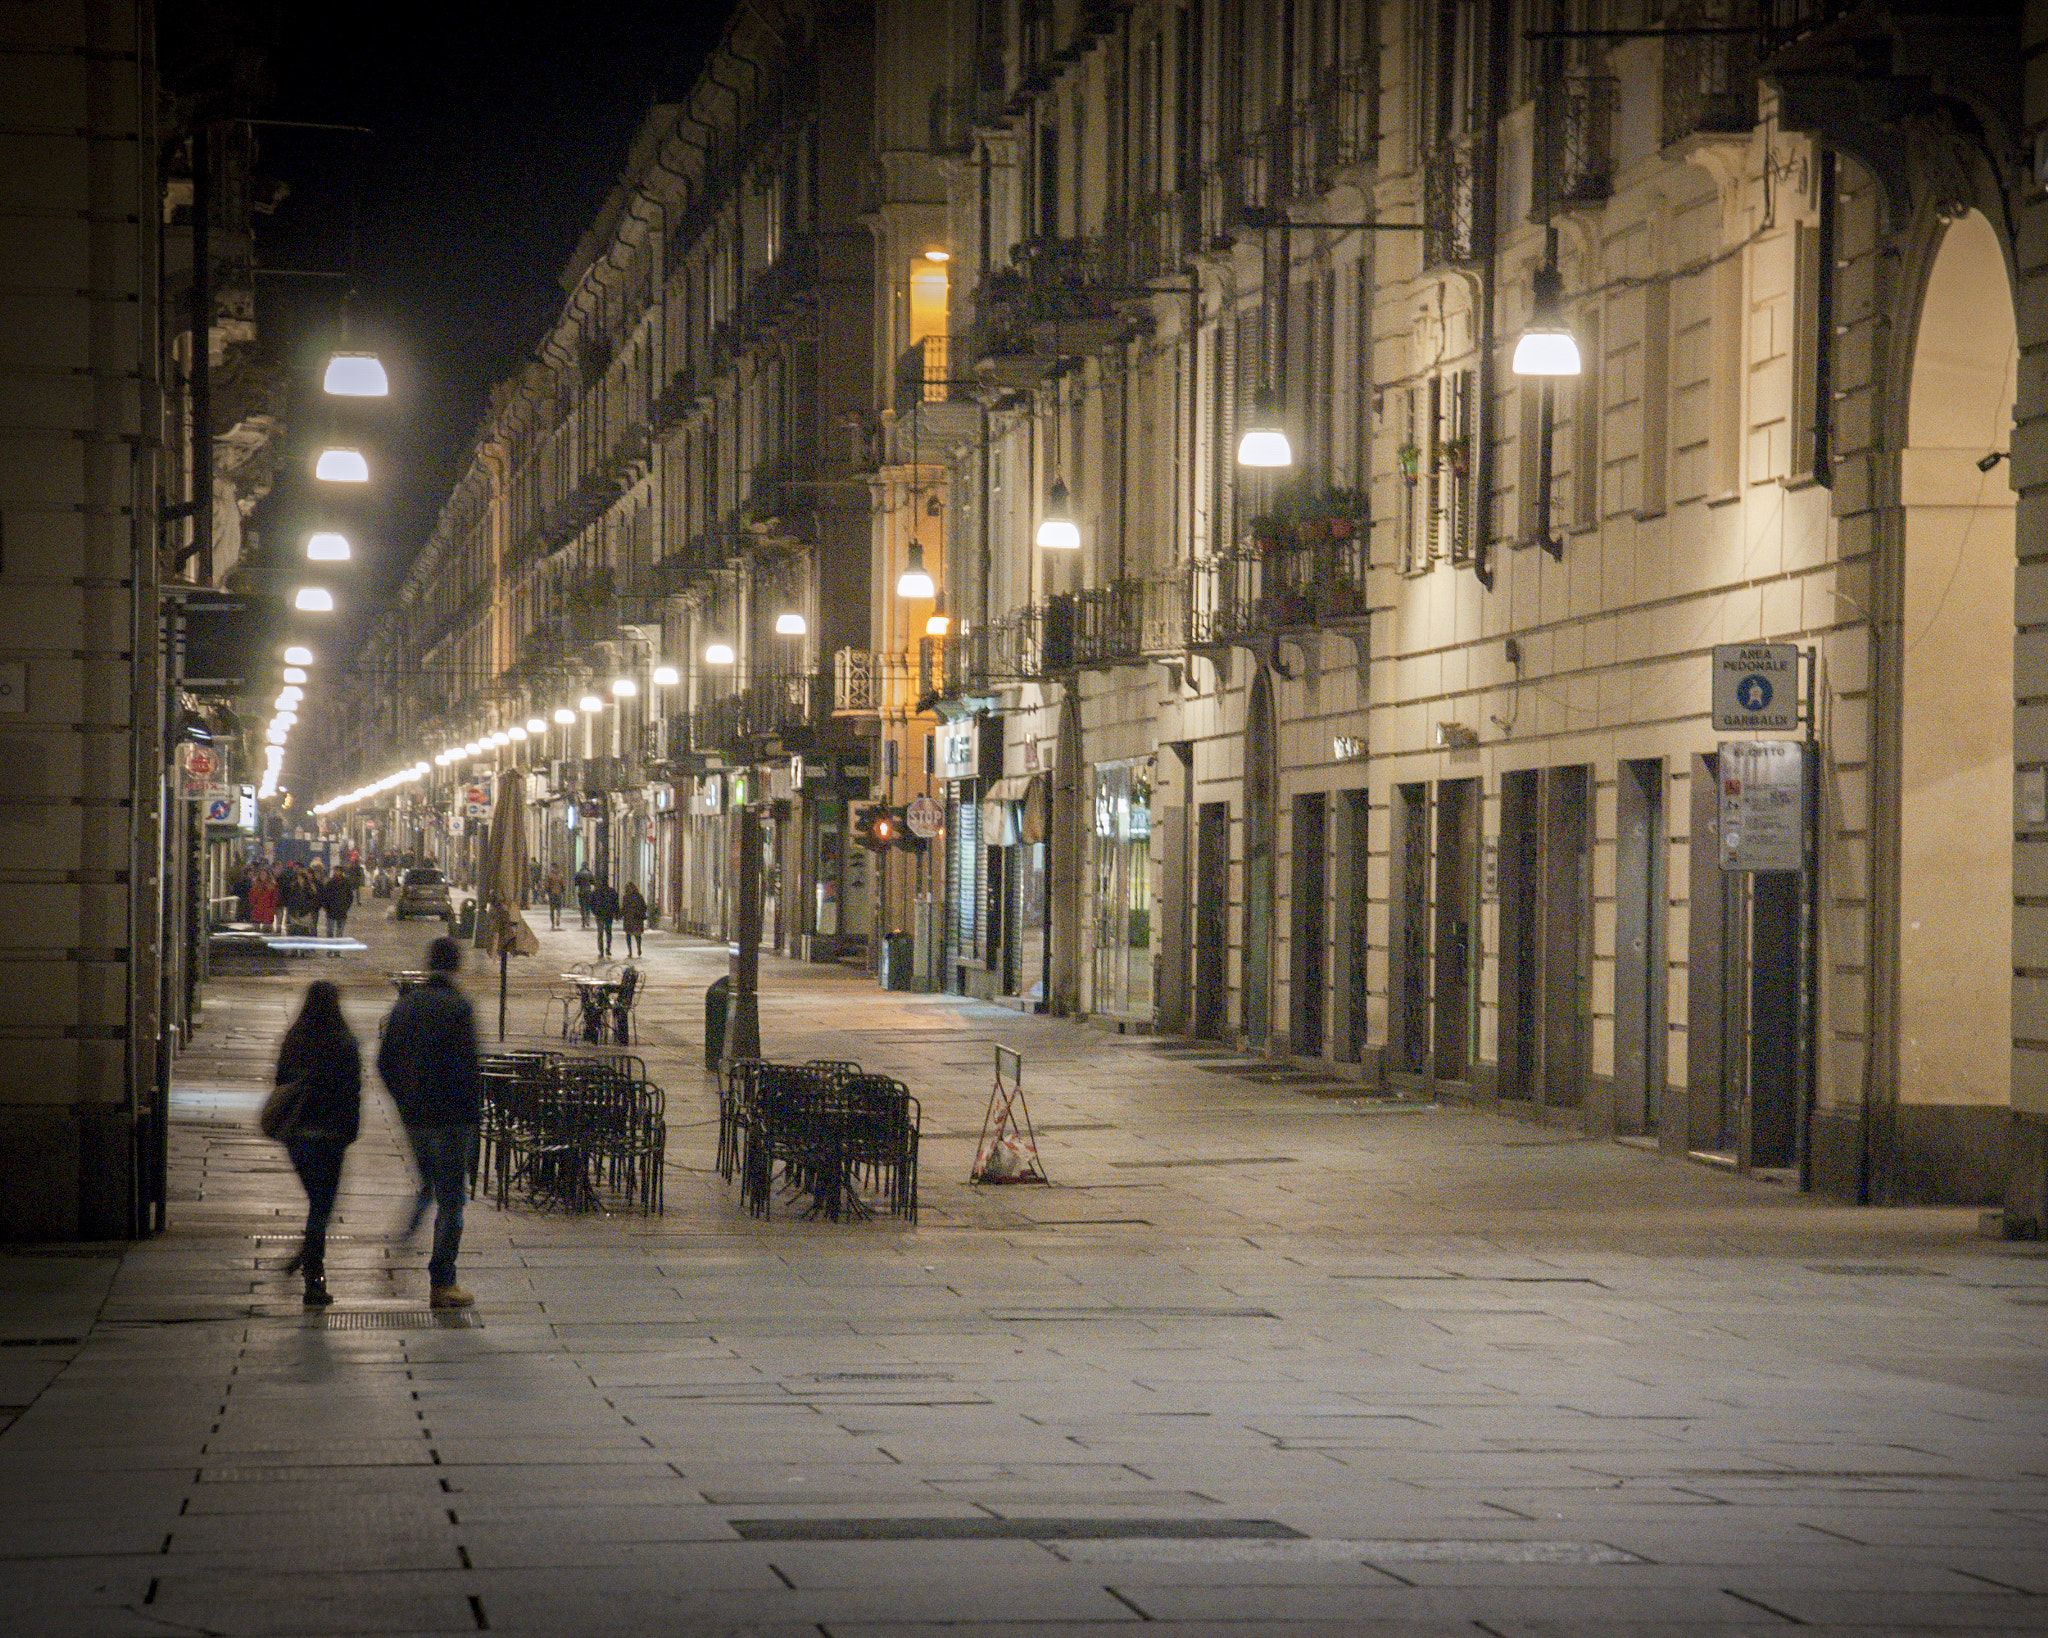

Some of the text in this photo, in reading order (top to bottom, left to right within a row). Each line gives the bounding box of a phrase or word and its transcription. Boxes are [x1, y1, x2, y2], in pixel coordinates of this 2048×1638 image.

[1740, 649, 1772, 659] AREA
[1723, 661, 1788, 671] PEDONALE
[1723, 715, 1788, 725] GARIBALDI
[909, 810, 942, 825] STOP
